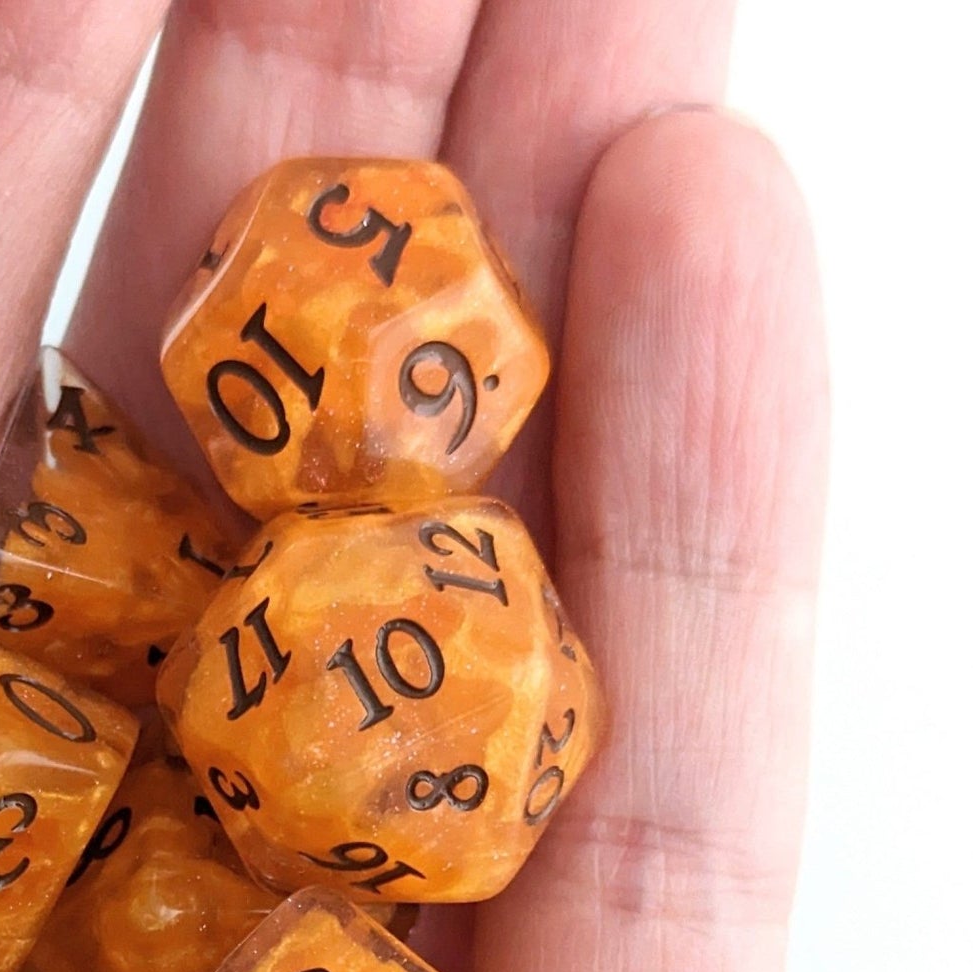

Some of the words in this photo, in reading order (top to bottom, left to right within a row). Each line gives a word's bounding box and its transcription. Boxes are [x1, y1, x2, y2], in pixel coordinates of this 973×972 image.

[307, 183, 412, 288] 5
[206, 302, 325, 457] 10
[418, 520, 510, 608] 12
[326, 617, 446, 732] 10
[208, 766, 260, 811] 3
[406, 763, 490, 813] 8
[524, 707, 576, 827] 20
